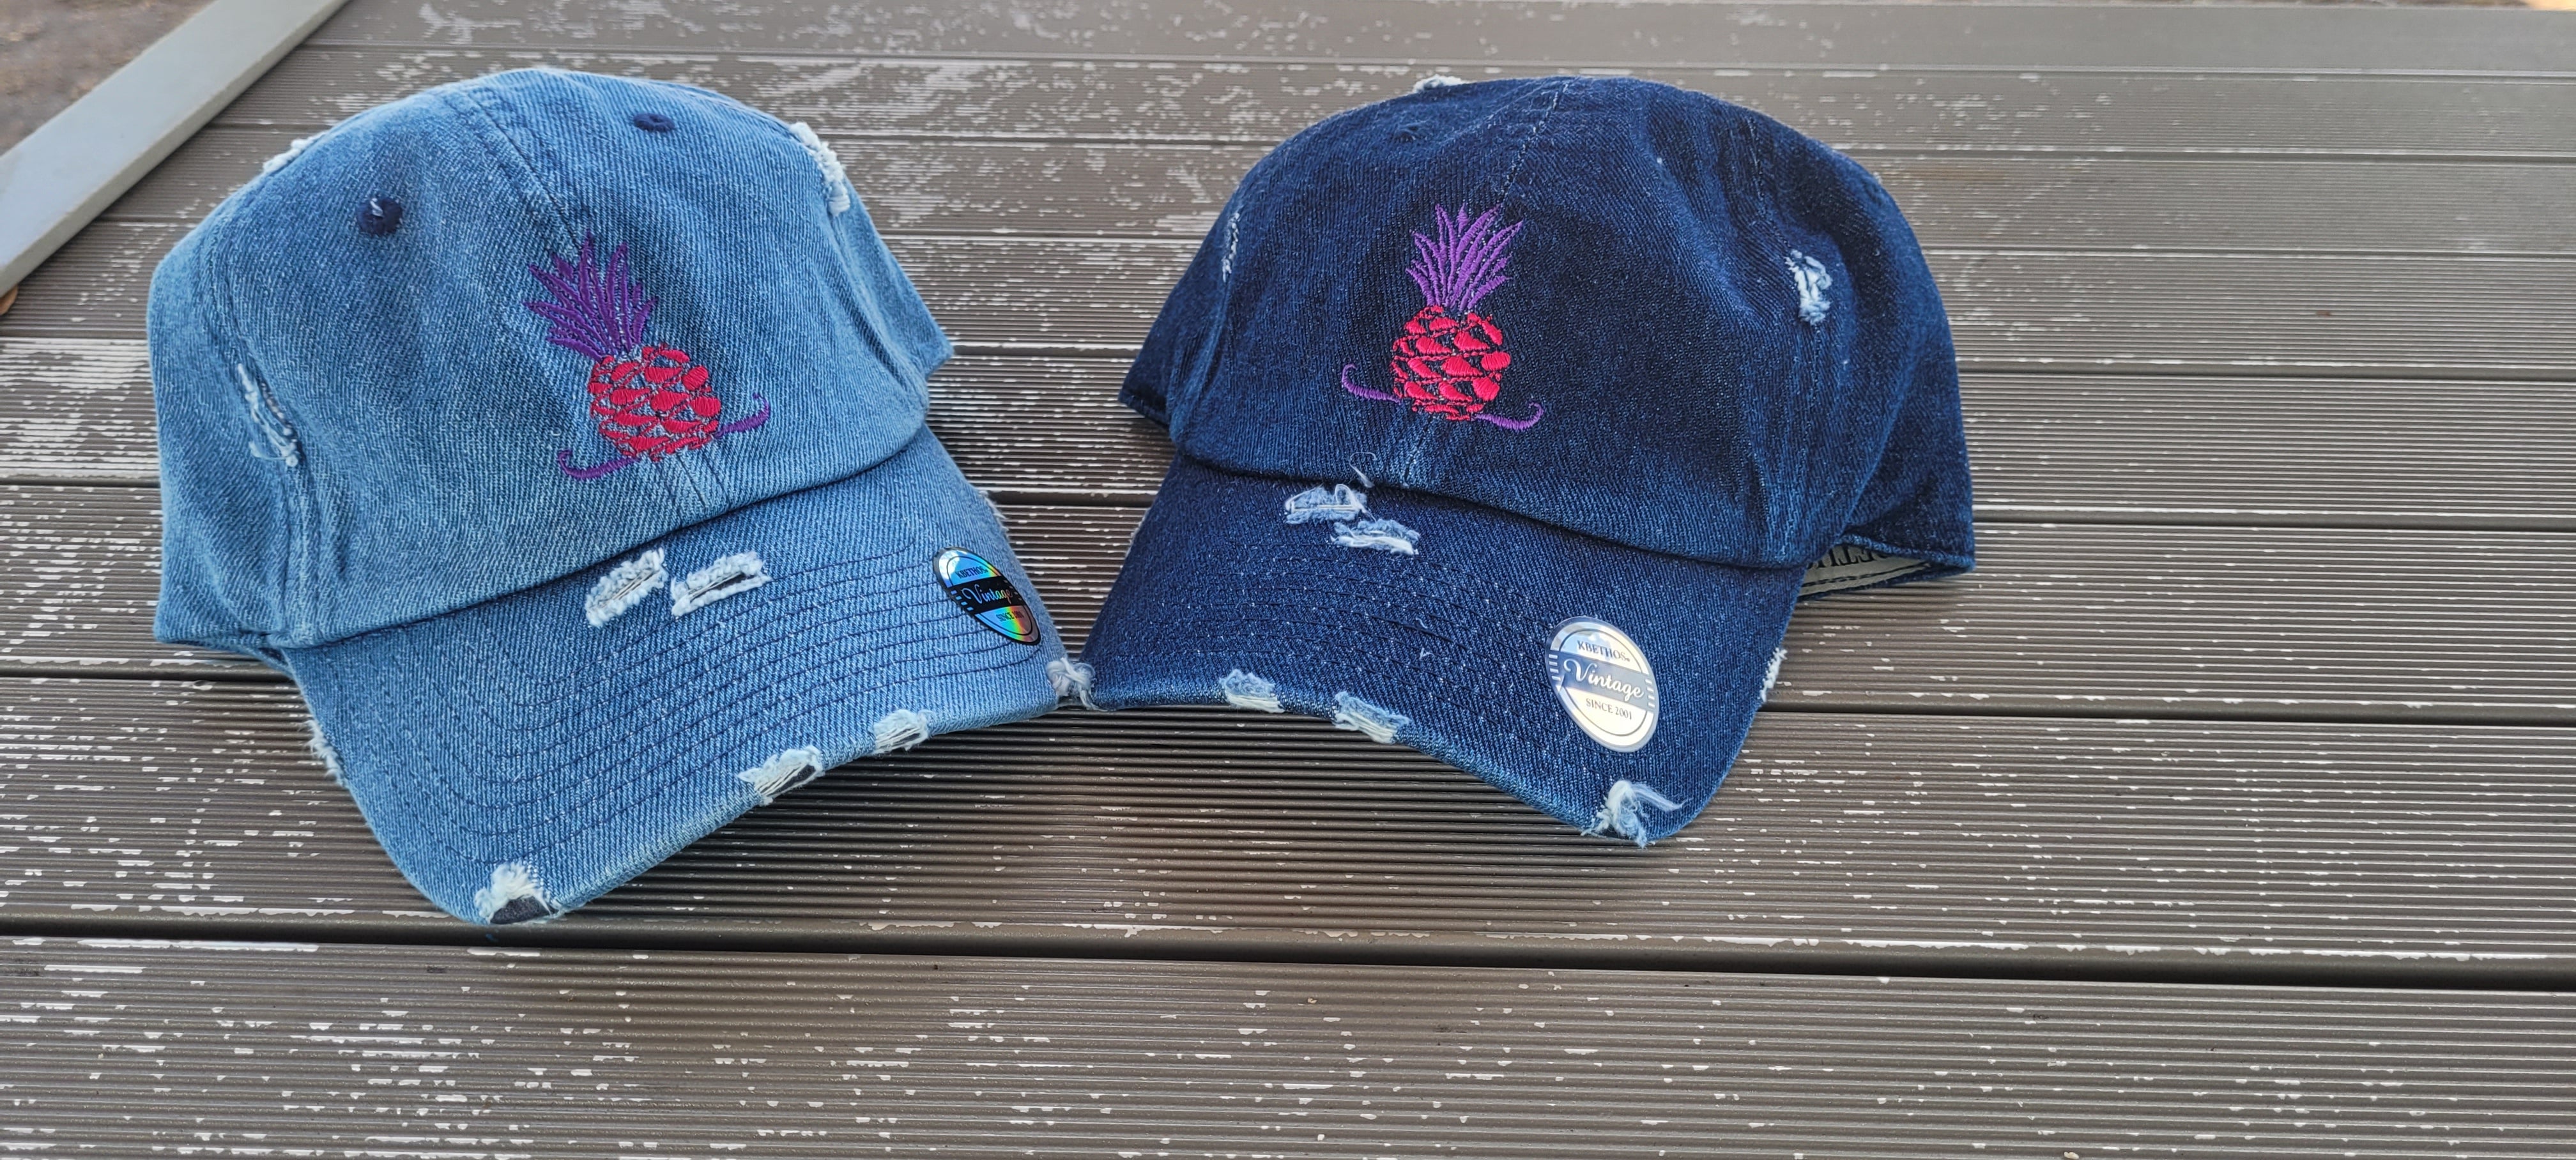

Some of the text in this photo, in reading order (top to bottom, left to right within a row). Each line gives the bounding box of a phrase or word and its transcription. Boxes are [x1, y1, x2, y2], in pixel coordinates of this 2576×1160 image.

[961, 584, 1013, 604] Vintage
[1563, 659, 1644, 701] Vintage
[1586, 698, 1632, 720] SINCE 2001
